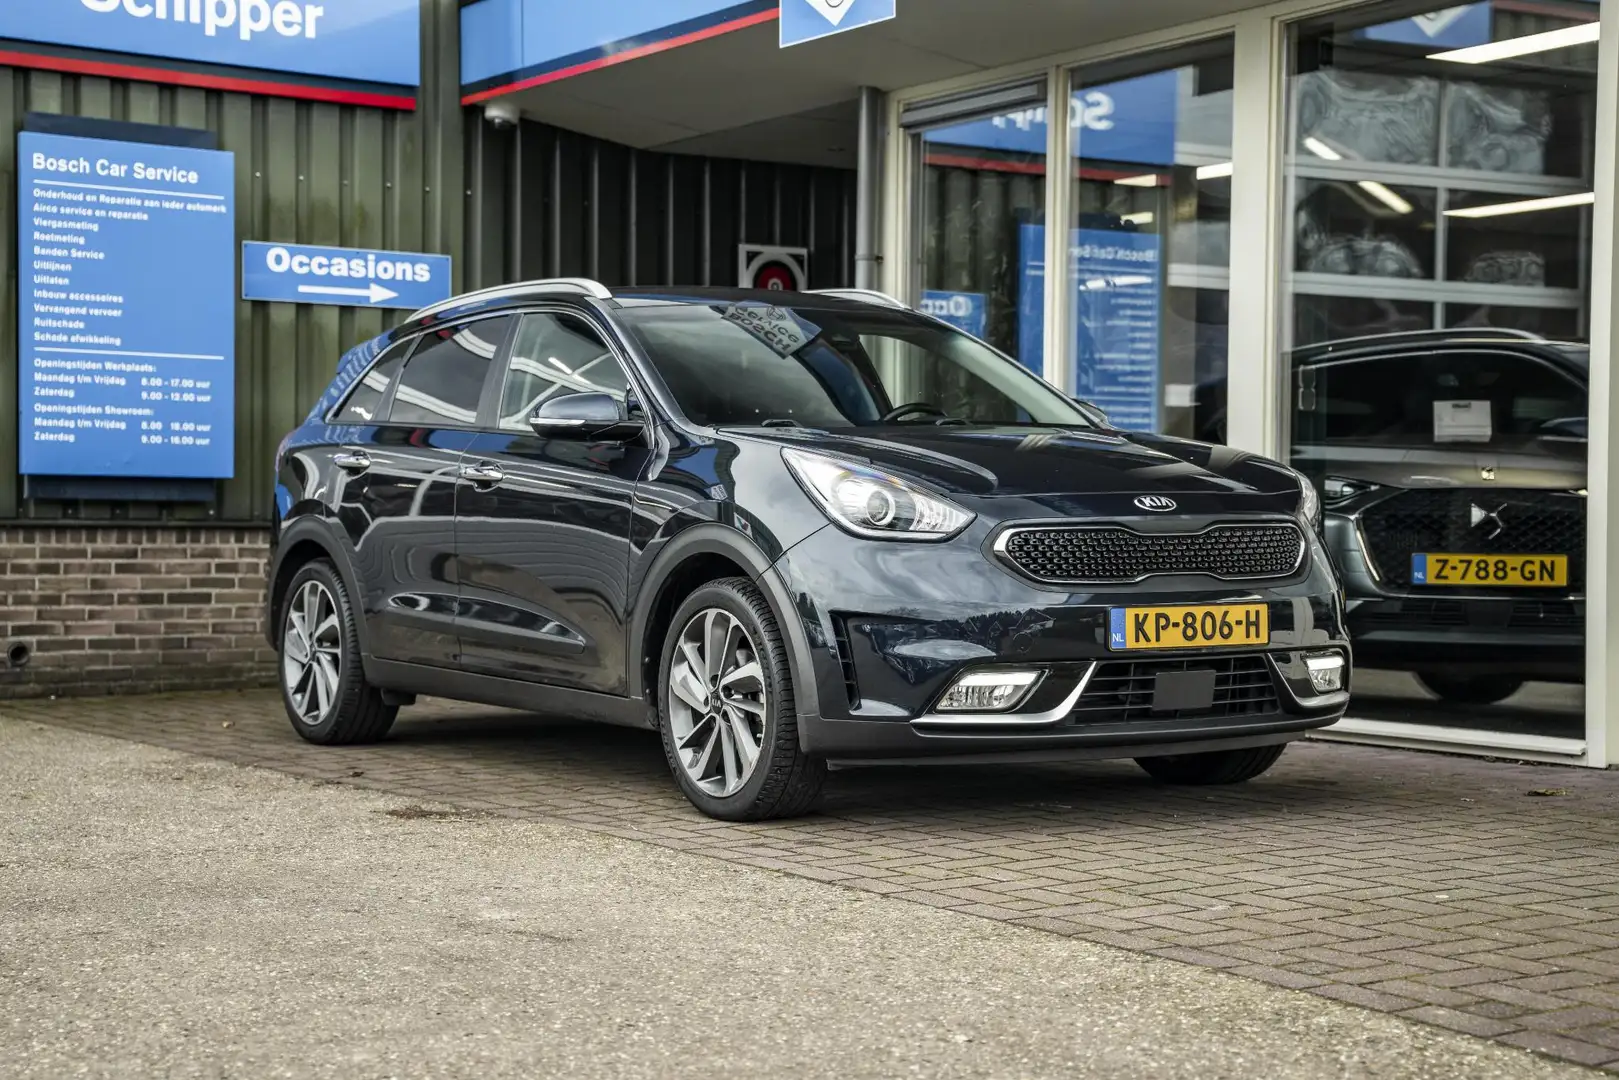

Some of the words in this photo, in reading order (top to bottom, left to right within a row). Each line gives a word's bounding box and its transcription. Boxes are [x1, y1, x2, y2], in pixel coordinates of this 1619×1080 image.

[81, 0, 323, 40] cpper
[32, 152, 90, 174] Bosch
[96, 158, 128, 177] Car
[133, 162, 199, 184] Service
[33, 187, 84, 202] Onderhoud
[85, 195, 98, 203] en
[99, 193, 142, 207] Reparatie
[33, 202, 58, 214] Airco
[59, 205, 94, 217] service
[94, 208, 107, 218] en
[108, 209, 149, 221] reparatie
[33, 216, 99, 232] Viergasmeting
[33, 231, 86, 245] Roetmeting
[33, 245, 69, 257] Banden
[70, 247, 106, 260] Service
[33, 260, 73, 272] Uitlijnen
[265, 246, 431, 283] Occasions
[33, 274, 70, 285] Uitlaten
[33, 288, 68, 300] Inbouw
[69, 291, 124, 303] accessoires
[33, 303, 88, 317] Vervangend
[88, 306, 123, 318] vervoer
[33, 317, 86, 329] Ruitschade
[33, 331, 69, 343] Schade
[70, 334, 122, 347] afwikkeling
[33, 358, 103, 371] Openingstijden
[104, 360, 157, 373] Werkplaats:
[33, 371, 76, 384] Maandag
[77, 373, 92, 384] t/m
[93, 374, 127, 386] Vrijdag
[33, 386, 76, 398] Zaterdag
[33, 402, 103, 415] Openingstijden
[33, 416, 76, 429] Maandag
[77, 418, 93, 428] t/m
[94, 419, 127, 431] Vrijdag
[33, 431, 76, 443] Zaterdag
[1138, 495, 1174, 508] KIA
[1434, 559, 1556, 582] Z-788-GN
[1112, 633, 1125, 642] NL
[1134, 609, 1261, 643] KP-806-H
